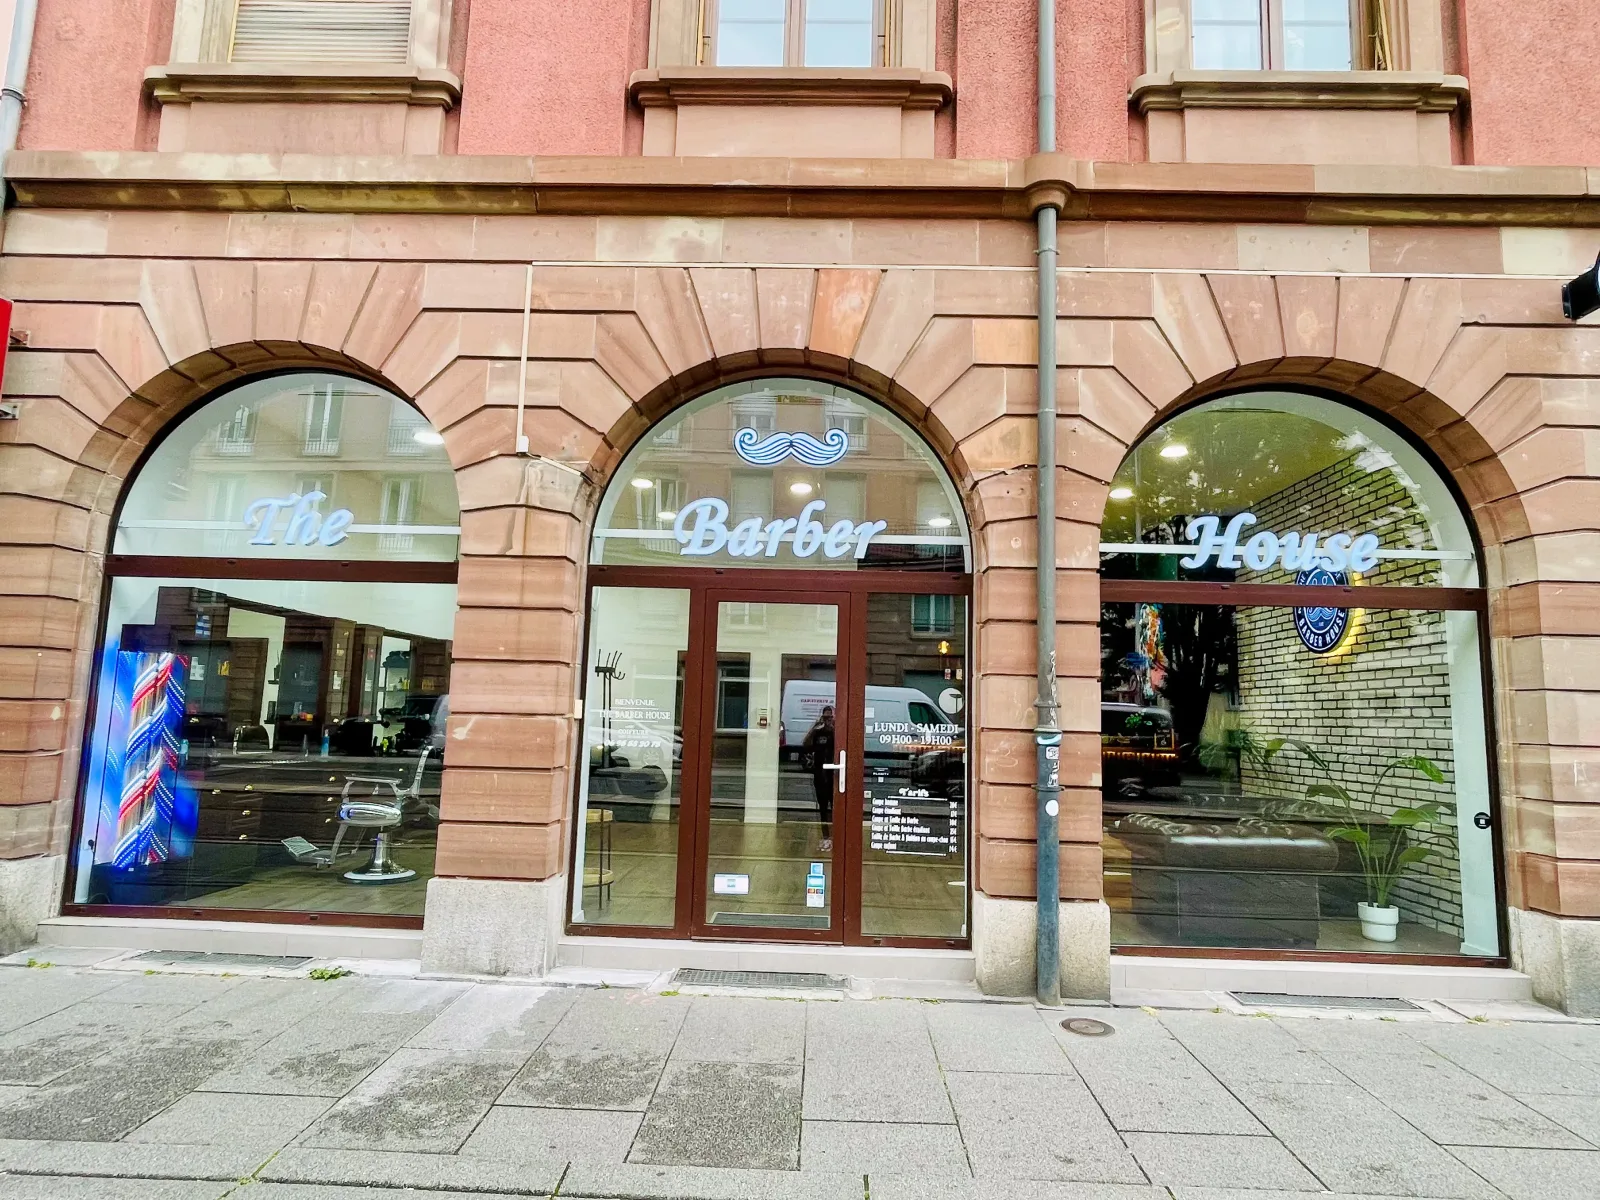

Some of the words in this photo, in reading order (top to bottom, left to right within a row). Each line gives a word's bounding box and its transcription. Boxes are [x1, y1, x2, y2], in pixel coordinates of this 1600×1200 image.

[244, 490, 355, 546] The
[673, 497, 888, 559] Barber
[1180, 512, 1379, 572] House
[1299, 618, 1323, 647] BARBER
[1325, 610, 1345, 644] HOUSE
[614, 698, 656, 706] BIENVENUE
[645, 711, 671, 720] HOUSE
[874, 722, 909, 733] LUNDI
[916, 723, 959, 734] SAMEDI
[879, 734, 912, 745] 09H00
[898, 787, 930, 797] Tarifs
